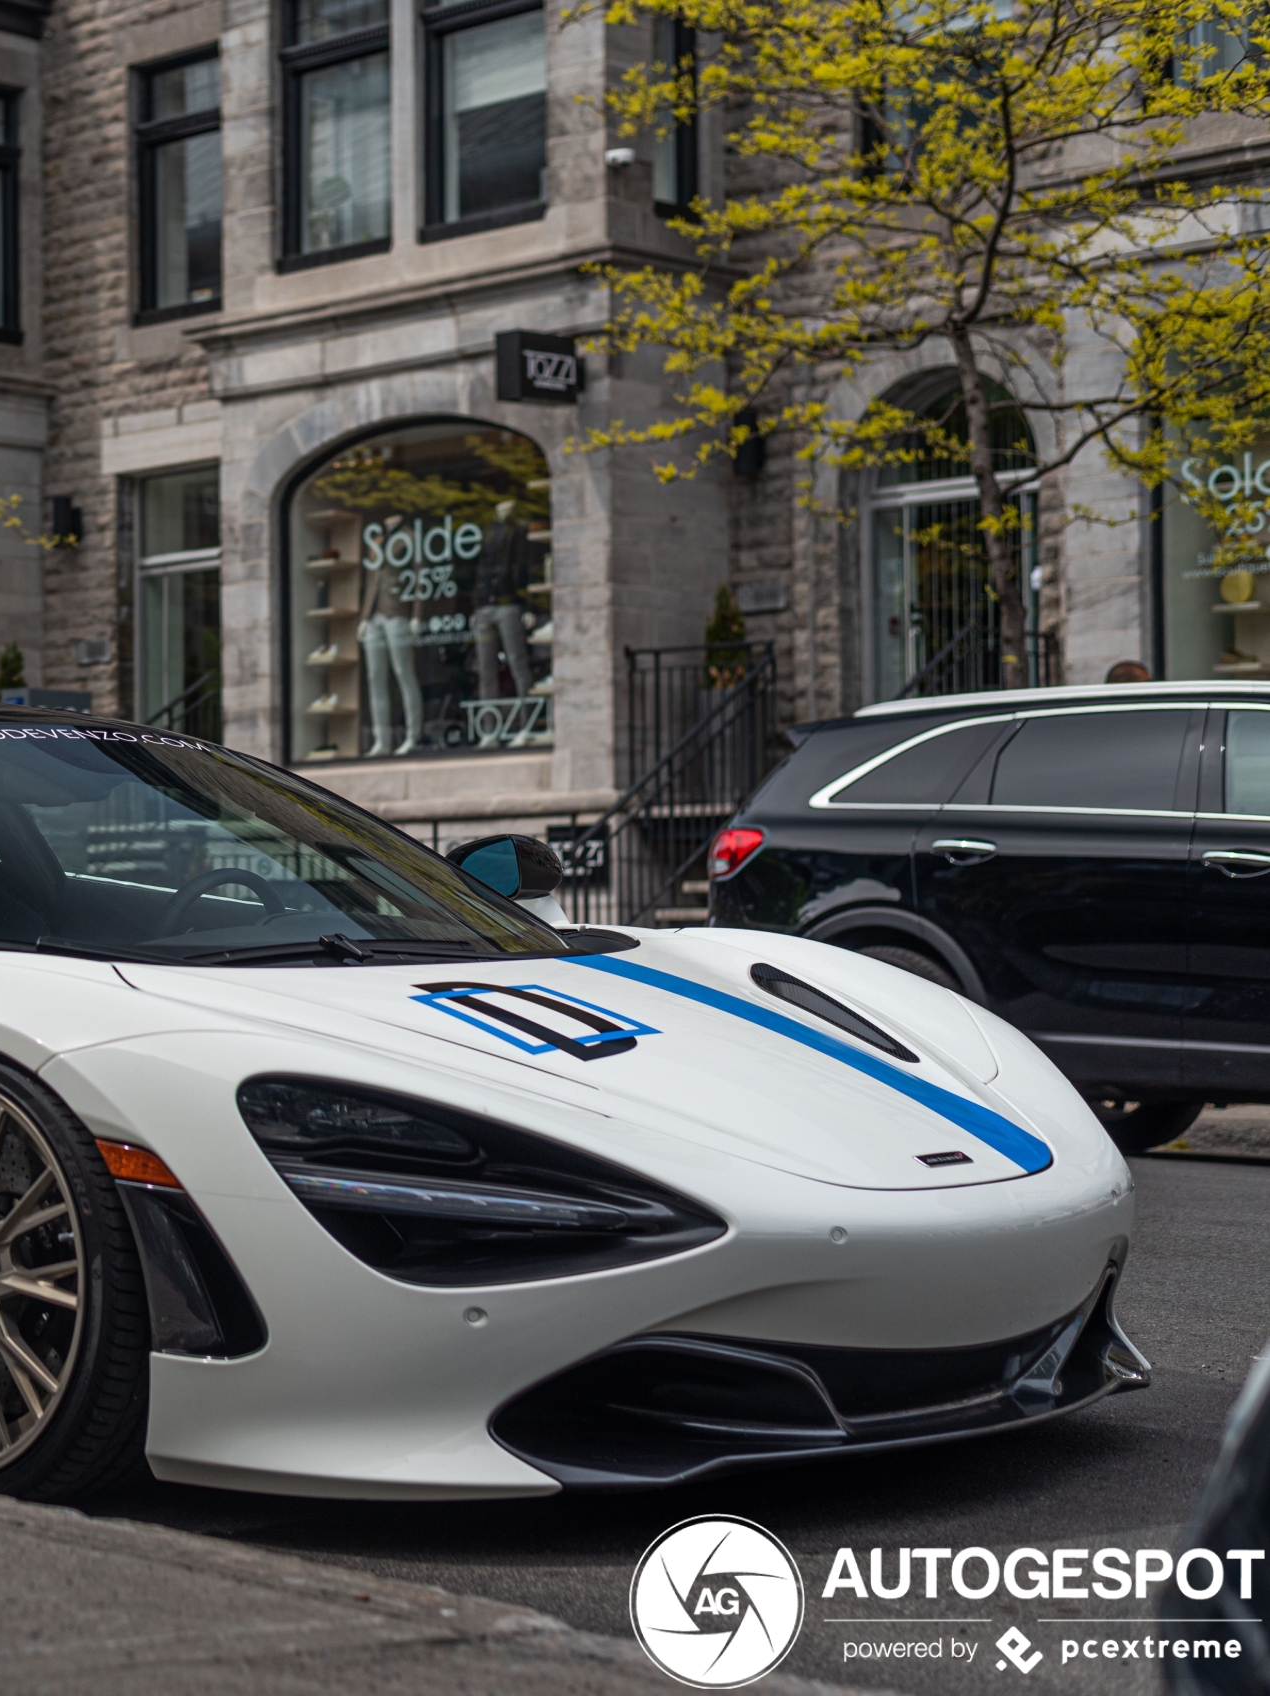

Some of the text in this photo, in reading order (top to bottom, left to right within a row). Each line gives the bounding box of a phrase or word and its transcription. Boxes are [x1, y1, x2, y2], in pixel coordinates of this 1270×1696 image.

[522, 348, 576, 386] TOZZI
[362, 514, 483, 571] Solde
[389, 563, 458, 602] -25%
[459, 697, 554, 743] TOZZI
